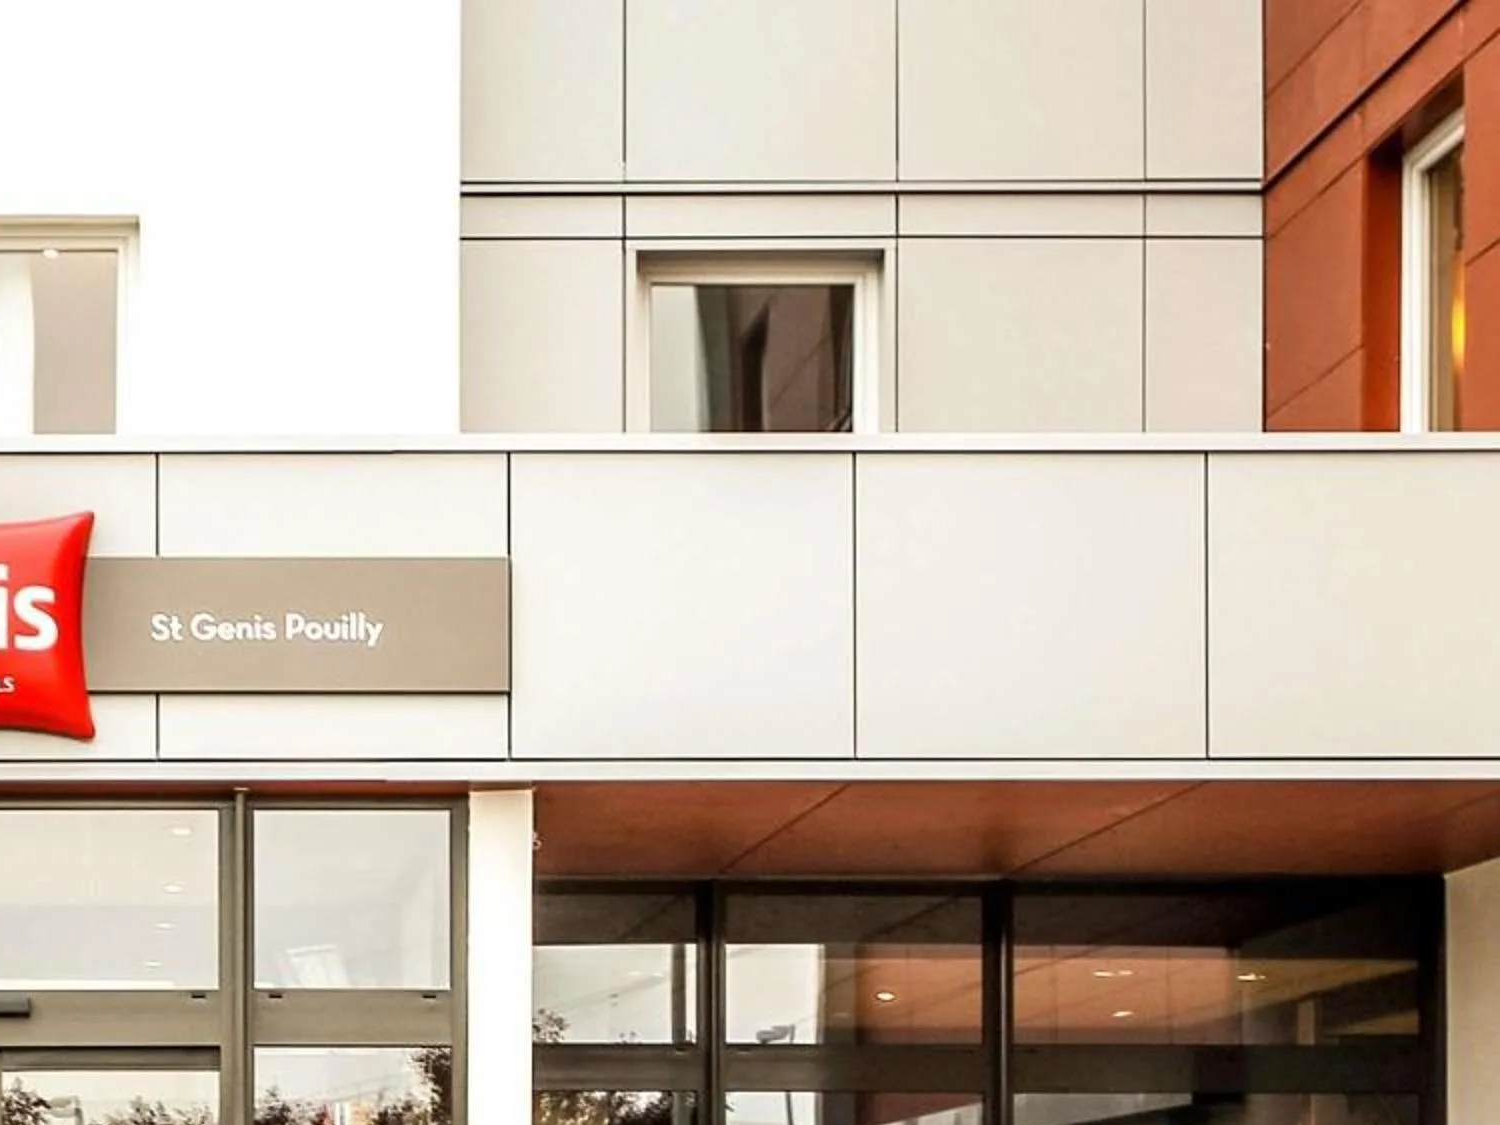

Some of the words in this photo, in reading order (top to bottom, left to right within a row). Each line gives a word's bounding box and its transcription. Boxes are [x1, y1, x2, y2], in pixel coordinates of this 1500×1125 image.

[151, 613, 184, 641] St
[190, 612, 277, 641] Genis
[285, 611, 384, 647] Pouilly
